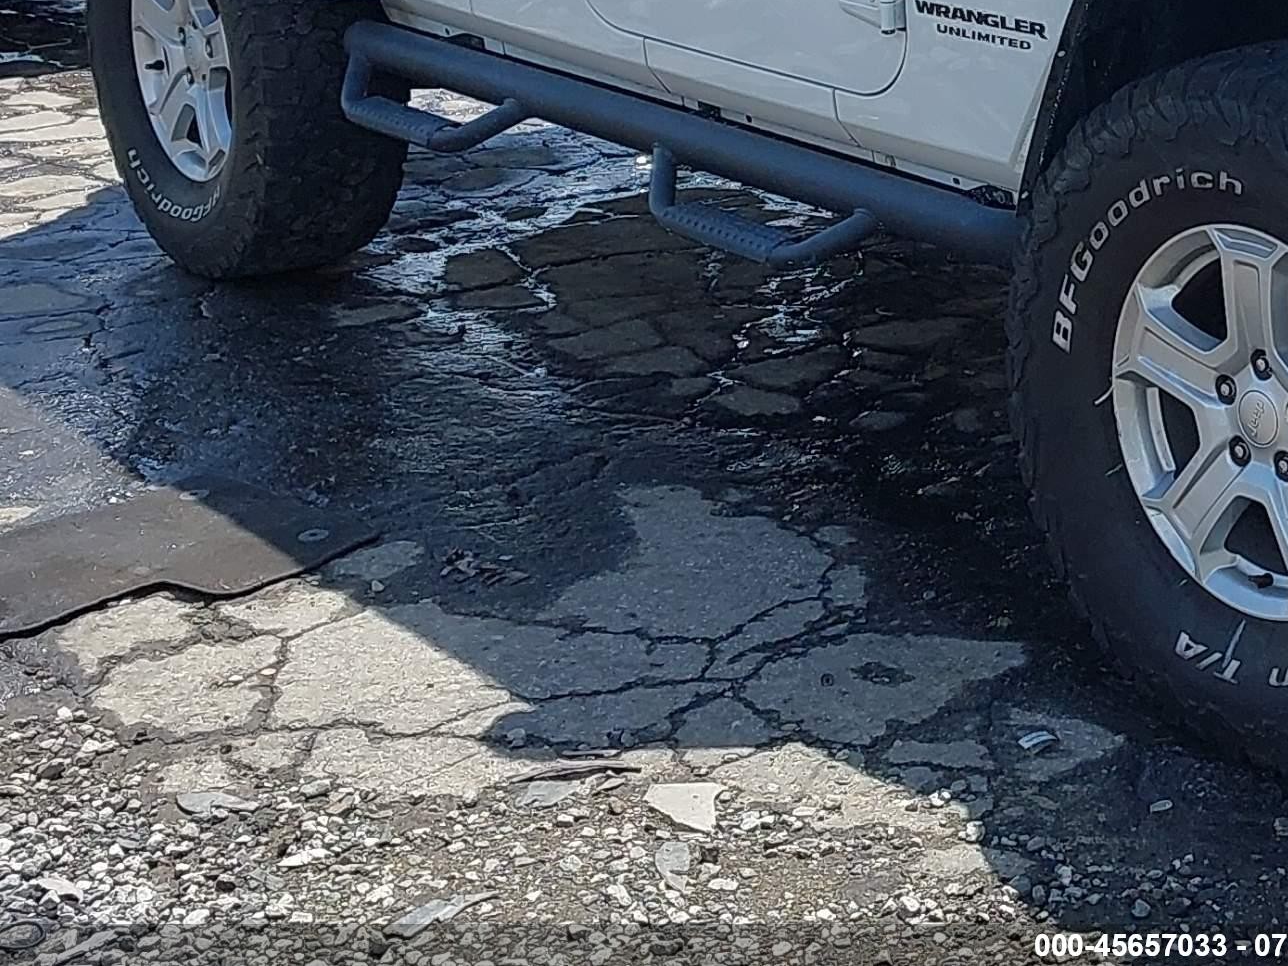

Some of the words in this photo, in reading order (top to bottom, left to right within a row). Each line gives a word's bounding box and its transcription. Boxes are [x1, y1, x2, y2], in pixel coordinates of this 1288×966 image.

[936, 23, 1032, 50] UNLIMITED
[1052, 167, 1243, 354] BFGoodrich
[1174, 631, 1242, 685] T/A
